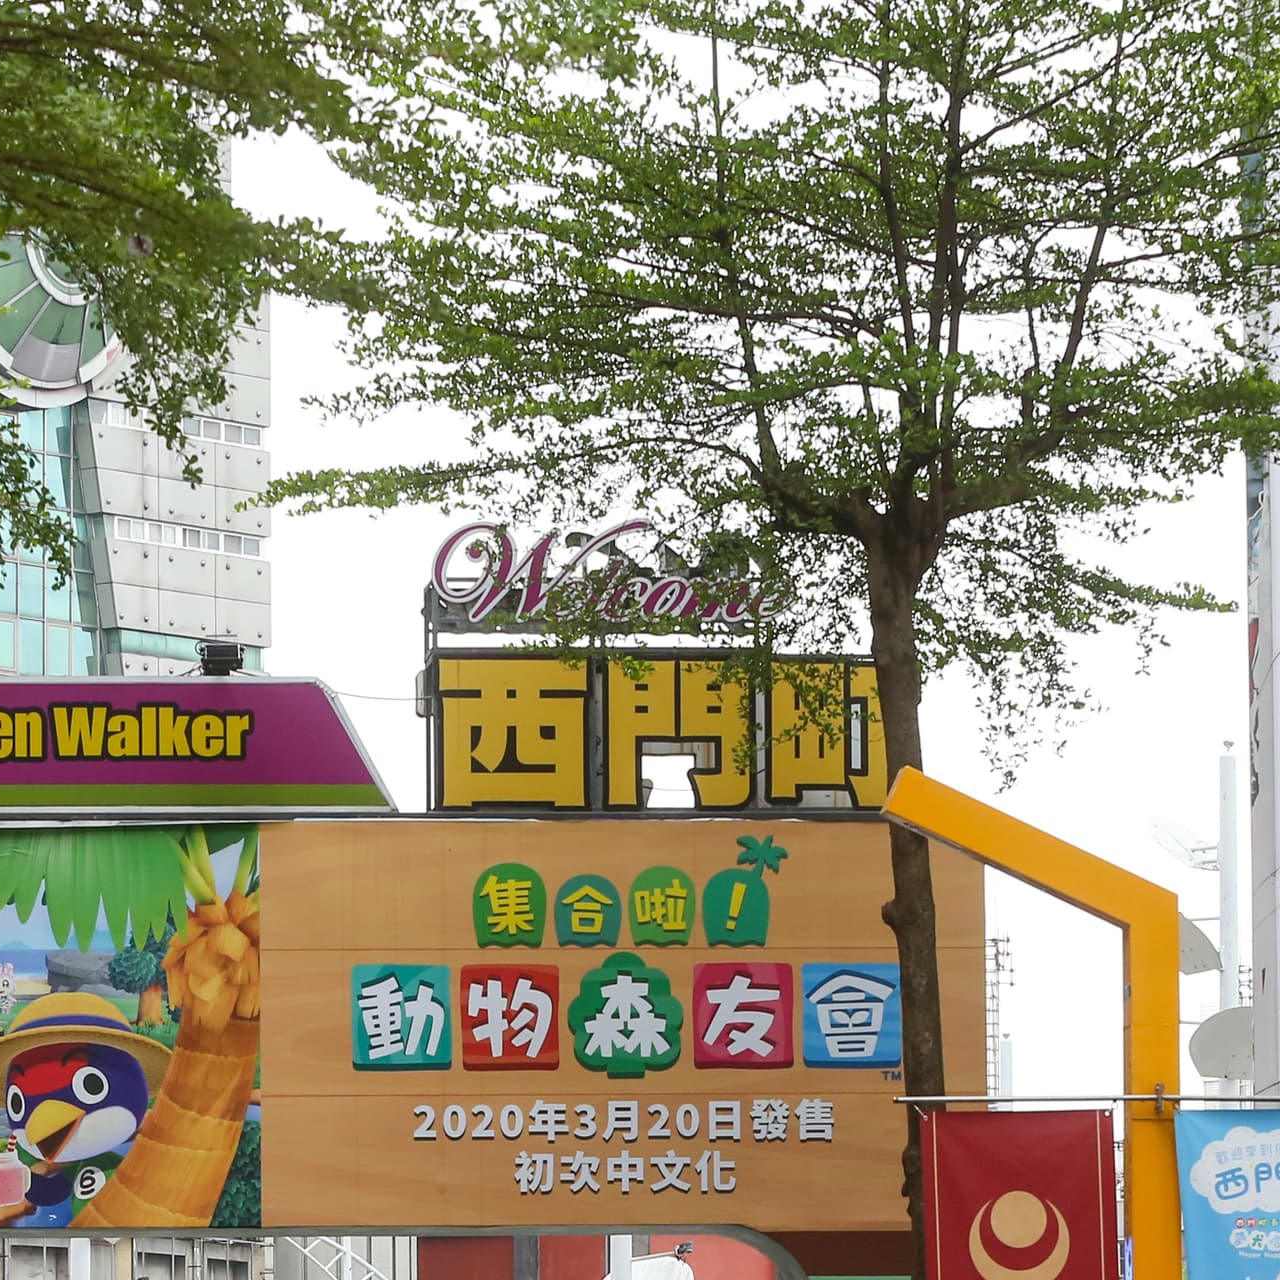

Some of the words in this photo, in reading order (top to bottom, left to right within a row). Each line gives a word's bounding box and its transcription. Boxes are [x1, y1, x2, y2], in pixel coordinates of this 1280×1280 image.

[51, 704, 252, 760] Walker
[436, 656, 890, 810] 西門町
[356, 969, 898, 1060] 動物森友會
[412, 1099, 836, 1143] 2020年3月20日發售
[514, 1150, 738, 1195] 初次中文化
